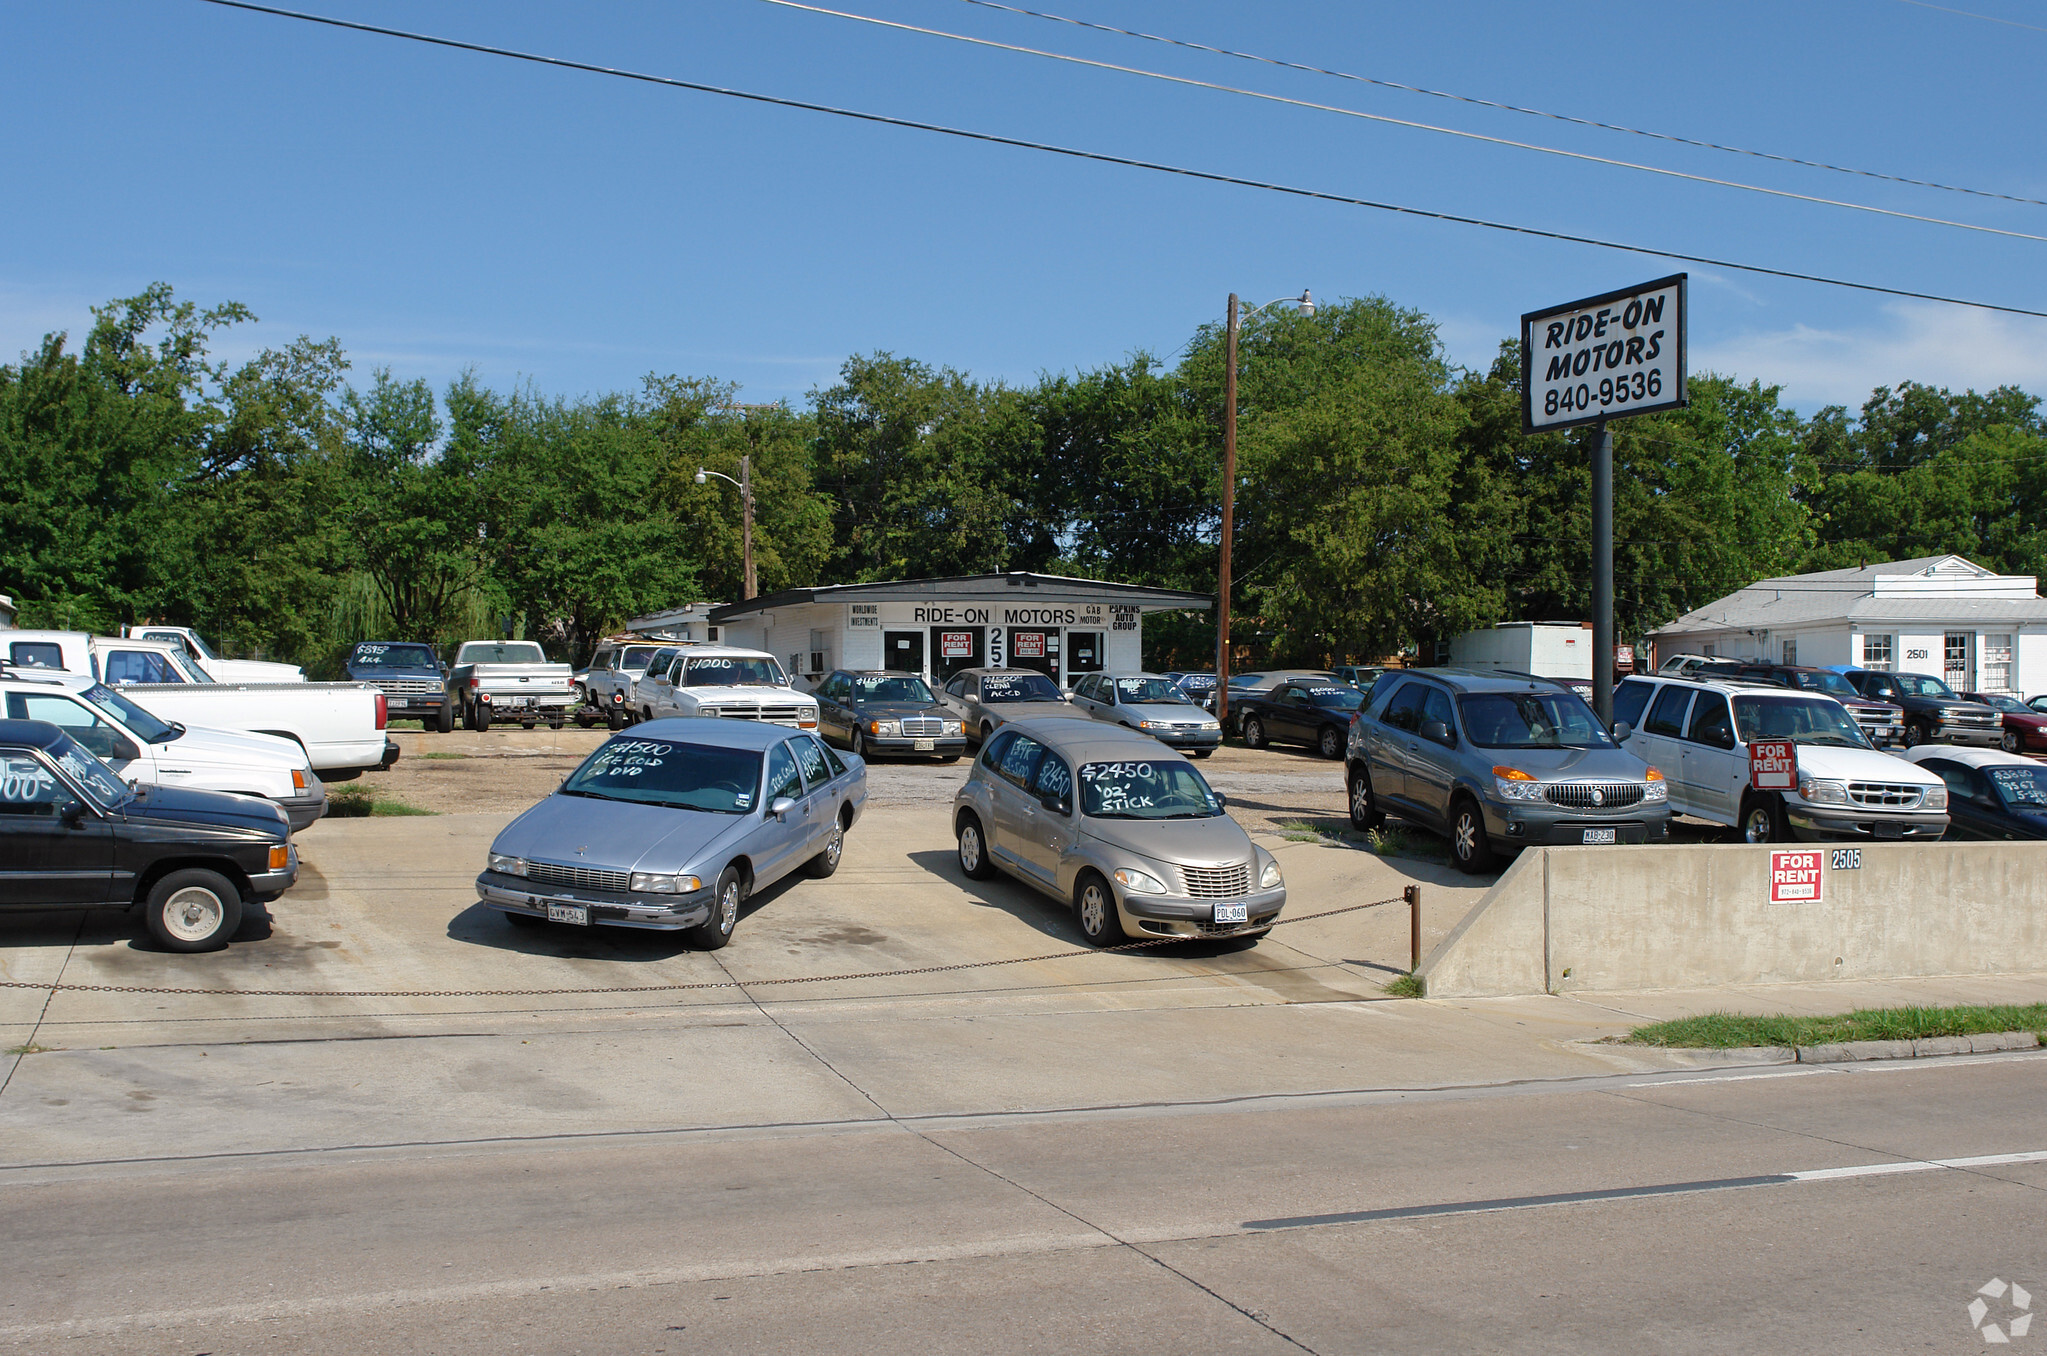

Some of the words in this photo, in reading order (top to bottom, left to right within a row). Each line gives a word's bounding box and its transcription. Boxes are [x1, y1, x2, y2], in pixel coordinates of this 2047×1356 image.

[1545, 295, 1665, 349] RIDE-ON
[1545, 330, 1665, 382] MOTORS
[1544, 368, 1662, 416] 840-9536
[852, 605, 877, 614] WORLDWIDE
[914, 607, 989, 623] RIDE-ON
[1005, 609, 1075, 624] MOTORS
[850, 617, 878, 626] INVESTMENTS
[1080, 616, 1101, 624] MOTOR
[1115, 613, 1135, 622] AUTO
[1112, 622, 1137, 630] GROUP
[1907, 650, 1928, 659] 2501
[688, 659, 732, 671] $1000
[1756, 745, 1787, 757] FOR
[1081, 762, 1152, 782] $2450
[1753, 759, 1792, 772] RENT
[1780, 855, 1814, 869] FOR
[1832, 849, 1861, 869] 2505
[1774, 869, 1820, 884] RENT
